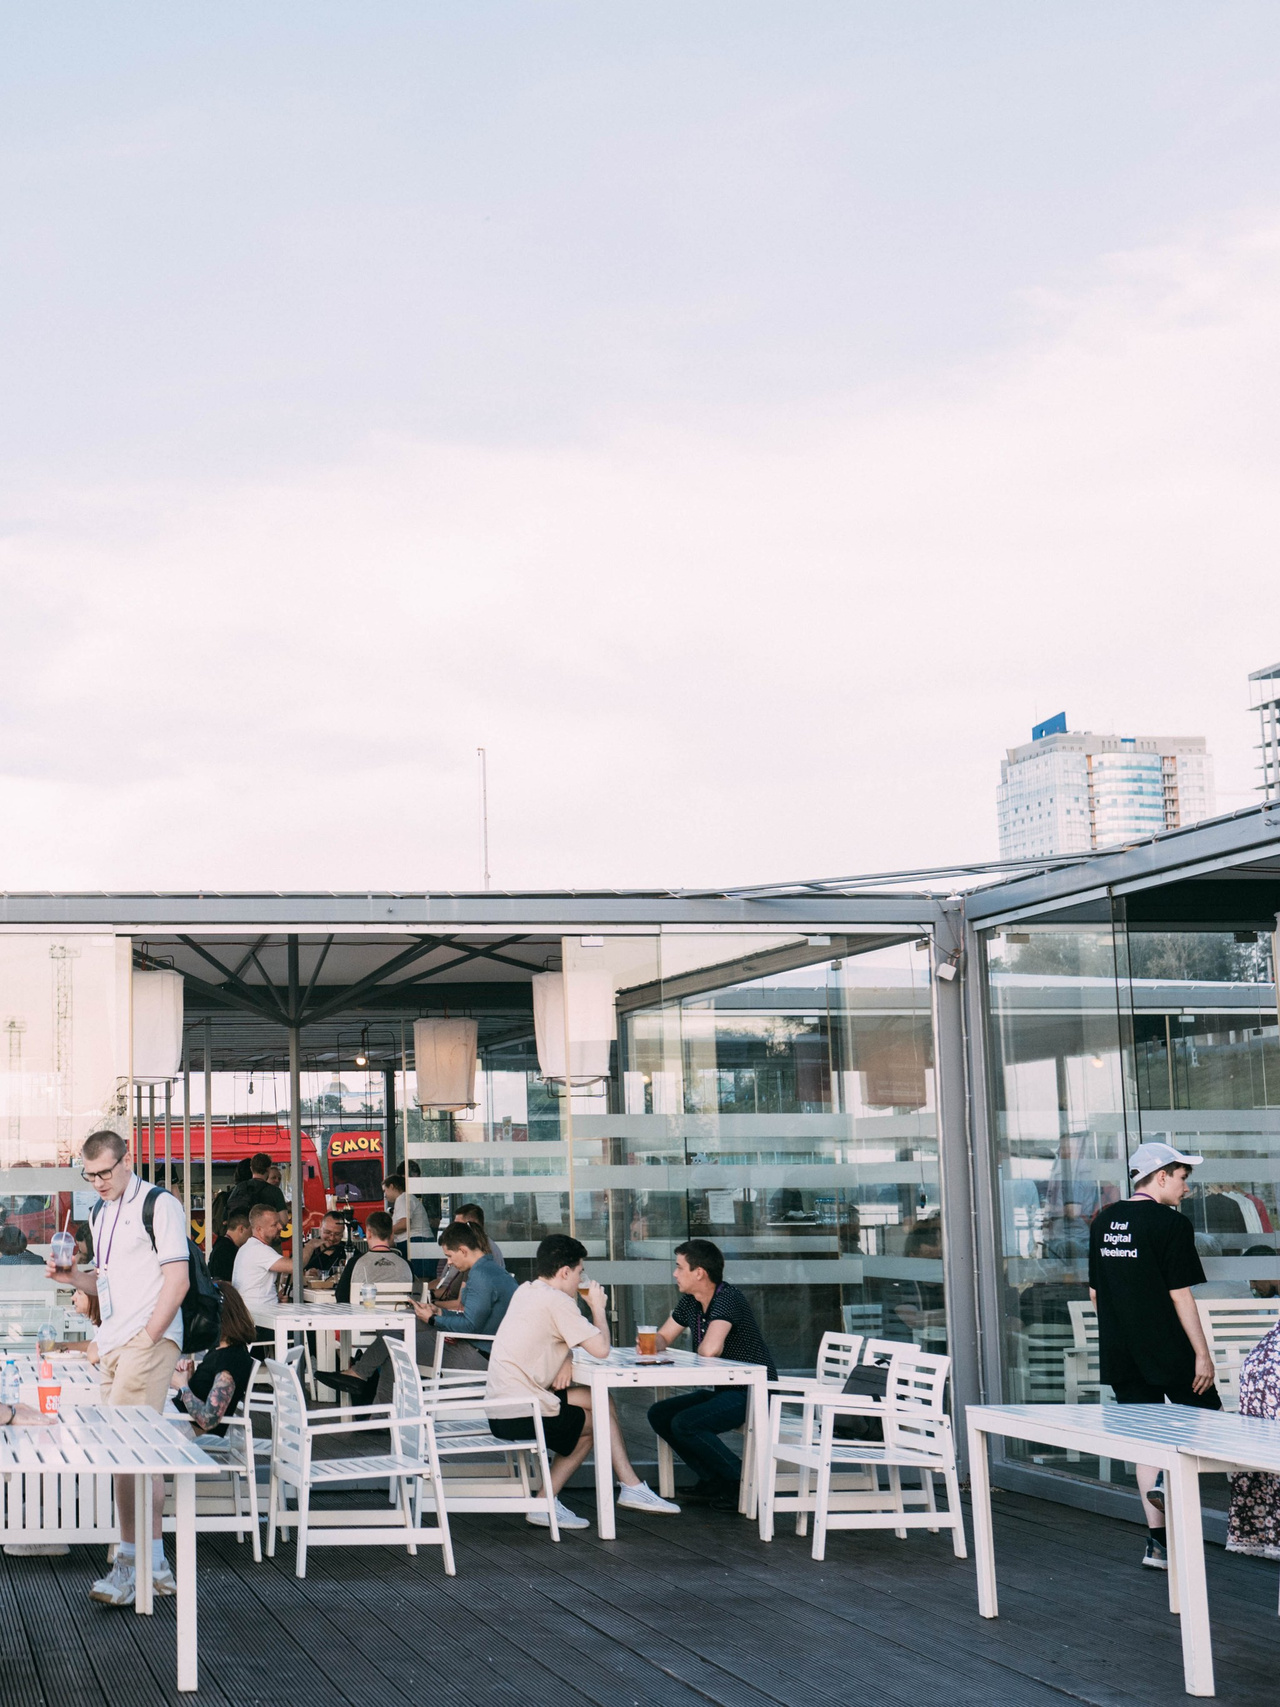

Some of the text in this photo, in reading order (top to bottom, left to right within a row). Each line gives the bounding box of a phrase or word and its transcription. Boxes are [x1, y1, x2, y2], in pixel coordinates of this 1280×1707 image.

[331, 1137, 383, 1156] SMOK
[1110, 1222, 1129, 1230] Ural
[1104, 1233, 1131, 1245] Digital
